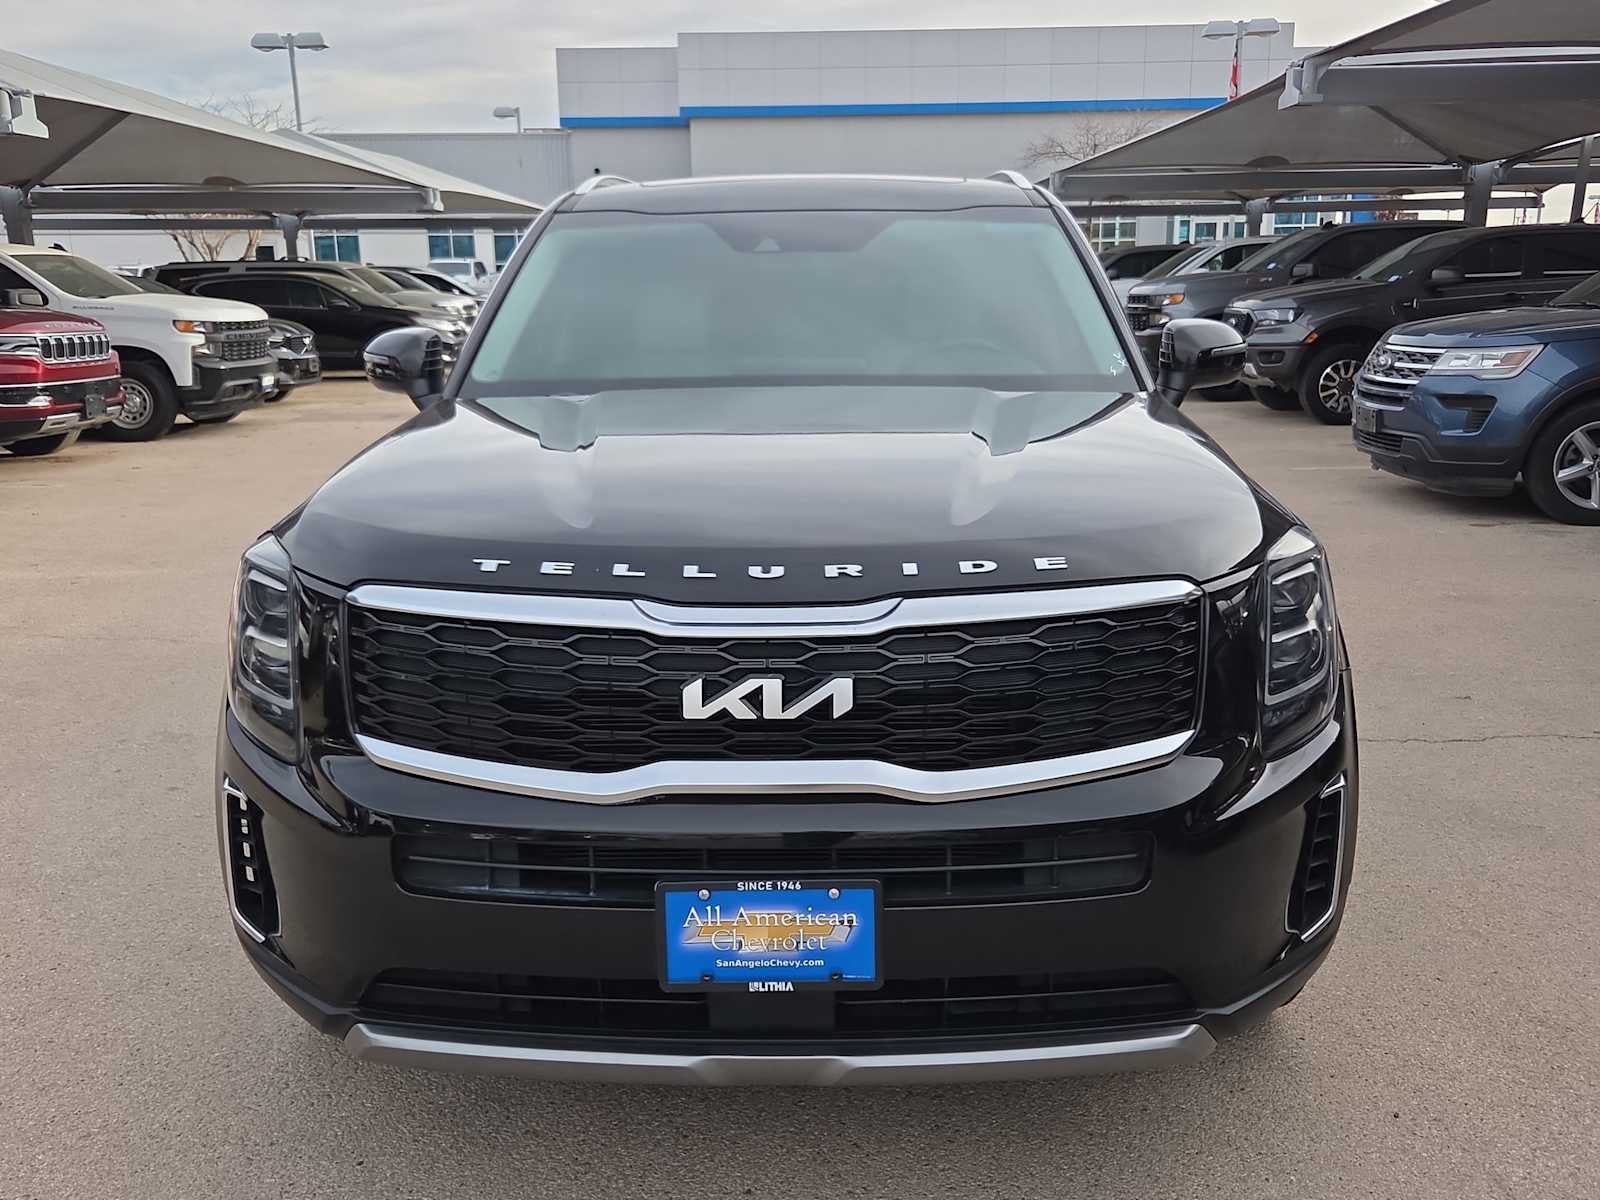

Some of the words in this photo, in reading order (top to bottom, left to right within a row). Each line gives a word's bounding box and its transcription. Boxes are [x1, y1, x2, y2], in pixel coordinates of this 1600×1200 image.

[473, 556, 1069, 579] TELLURIDE
[682, 677, 854, 720] KIA
[737, 882, 772, 890] SINCE
[776, 882, 801, 890] 1946
[683, 906, 721, 927] All
[734, 907, 858, 927] American
[712, 929, 826, 951] Chevrolet
[716, 959, 824, 968] SanAngeloChevy.com
